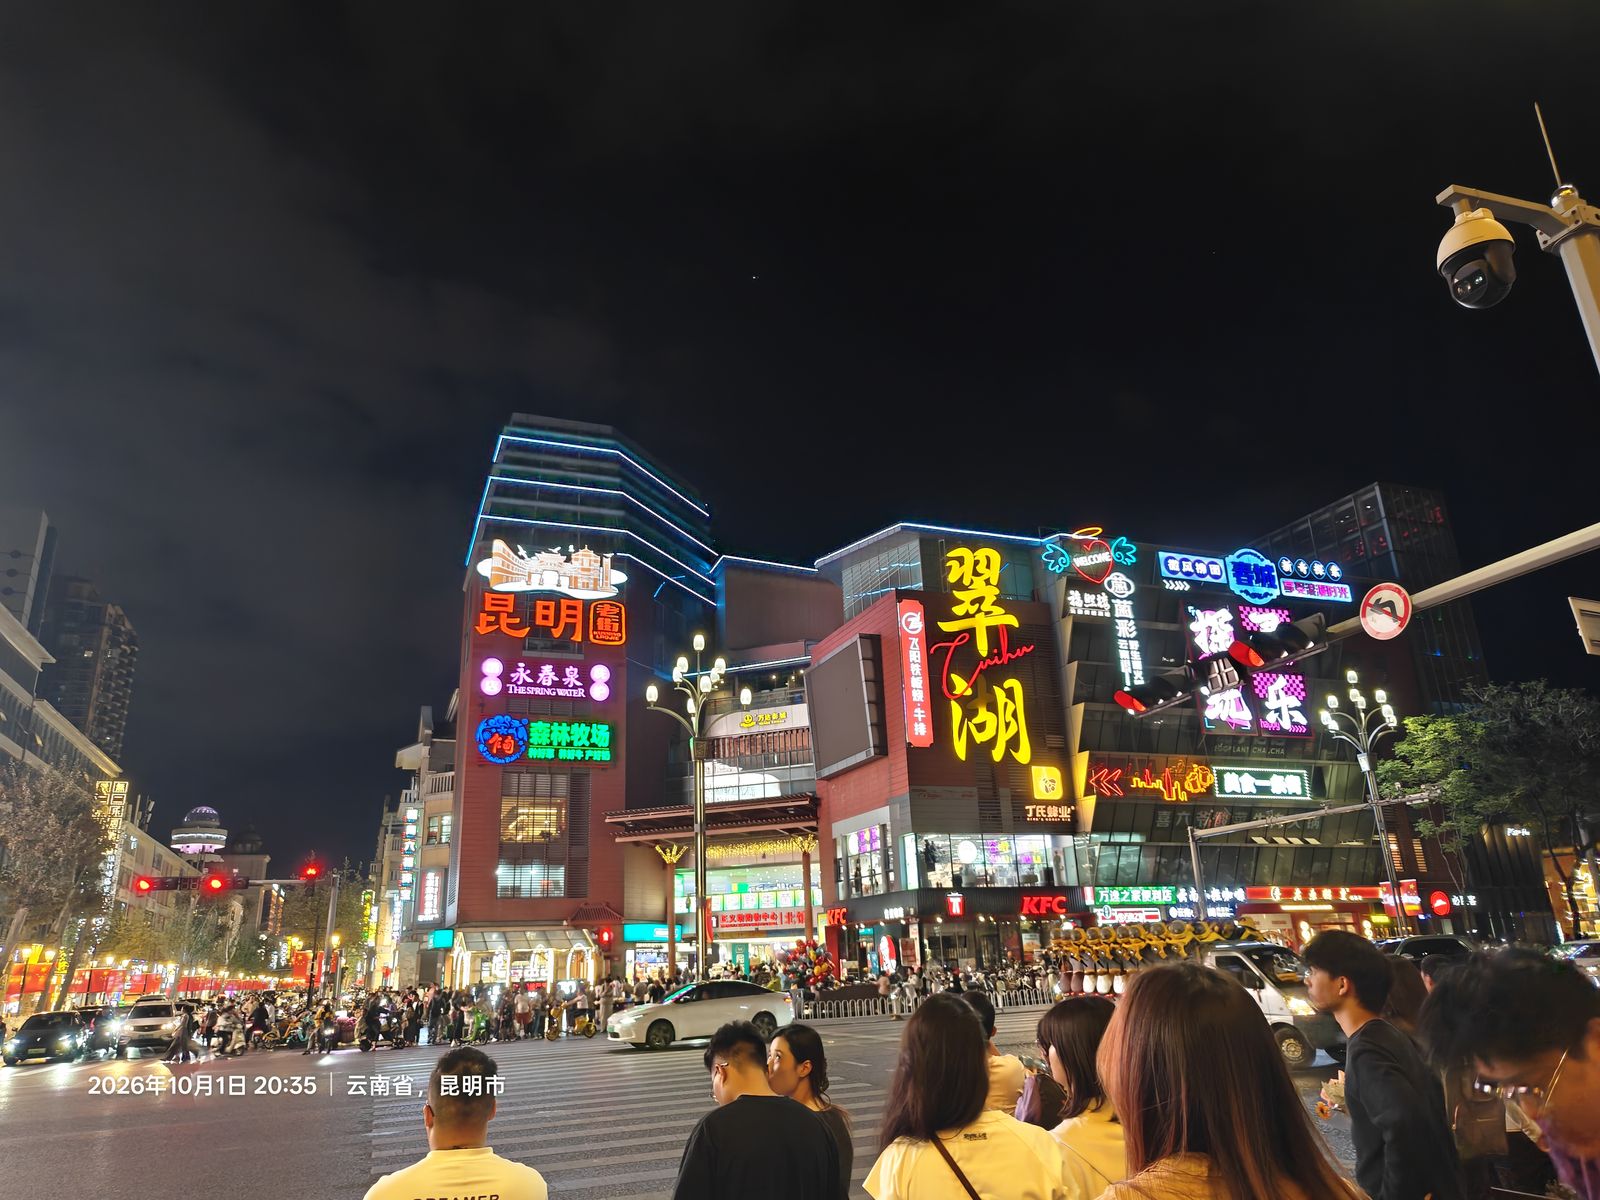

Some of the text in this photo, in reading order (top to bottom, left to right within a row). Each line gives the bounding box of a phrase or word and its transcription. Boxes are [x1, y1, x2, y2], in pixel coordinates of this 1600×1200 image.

[1073, 552, 1112, 567] WELCOME
[1231, 561, 1278, 589] 春城
[474, 592, 583, 642] 昆明
[596, 603, 620, 632] 老街
[937, 546, 1032, 765] 翠湖
[510, 662, 583, 688] 永春泉
[526, 687, 556, 697] SPRING
[556, 689, 587, 698] WATER
[529, 721, 610, 748] 森林牧场
[1260, 718, 1281, 731] happy
[1025, 805, 1071, 818] 丁氏蜂业
[827, 907, 847, 925] KFC
[1022, 896, 1067, 914] KFC
